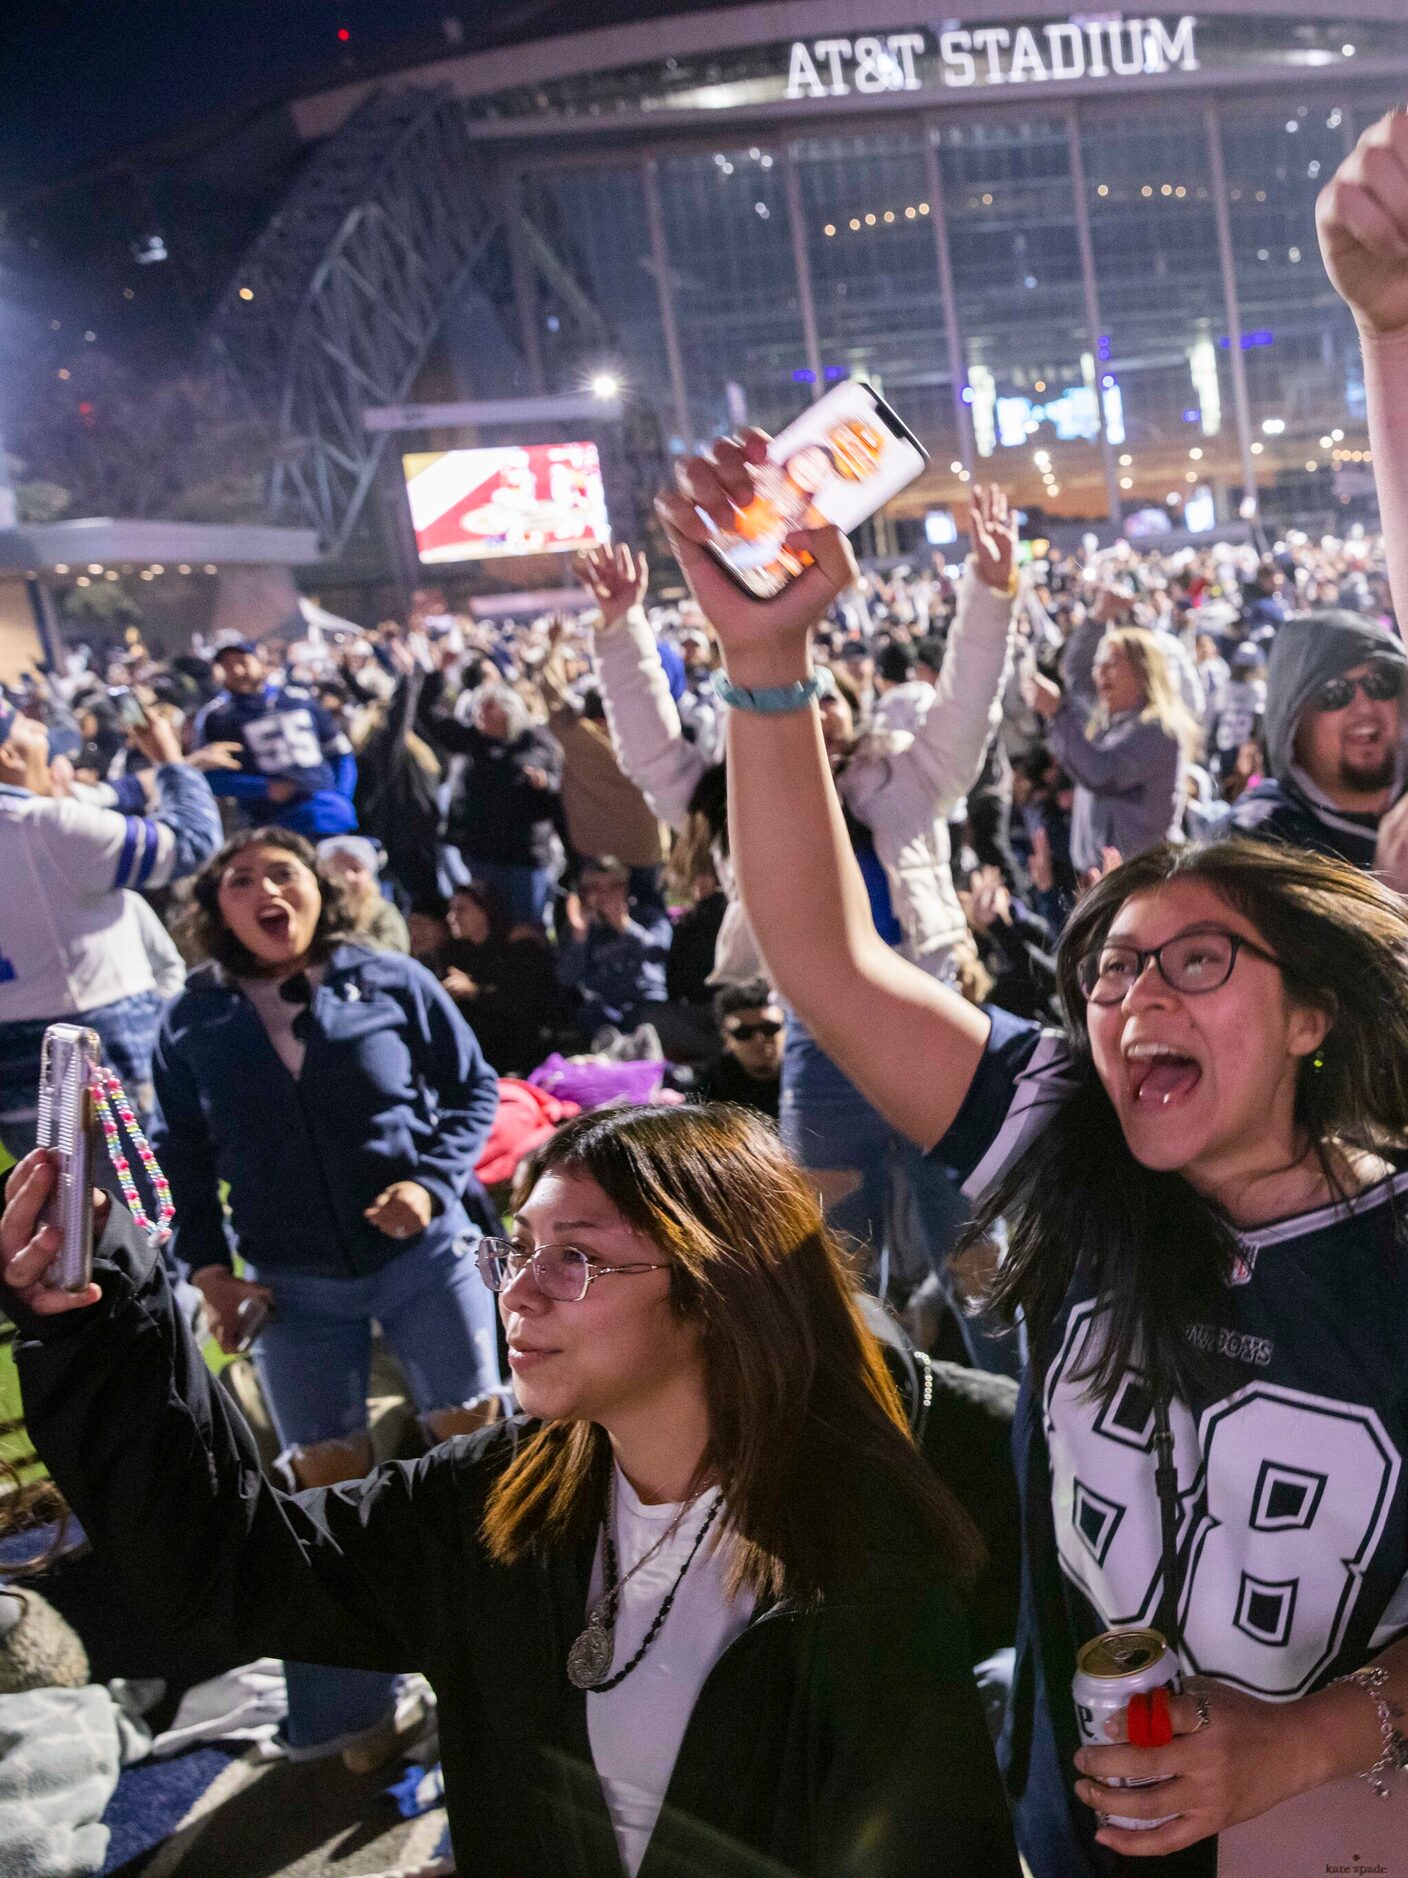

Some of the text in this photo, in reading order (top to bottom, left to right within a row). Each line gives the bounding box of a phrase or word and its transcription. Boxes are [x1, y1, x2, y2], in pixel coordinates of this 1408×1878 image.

[784, 16, 1200, 99] AT&T STADIUM
[1043, 1298, 1402, 1702] 88
[1326, 1863, 1388, 1876] kate spade
